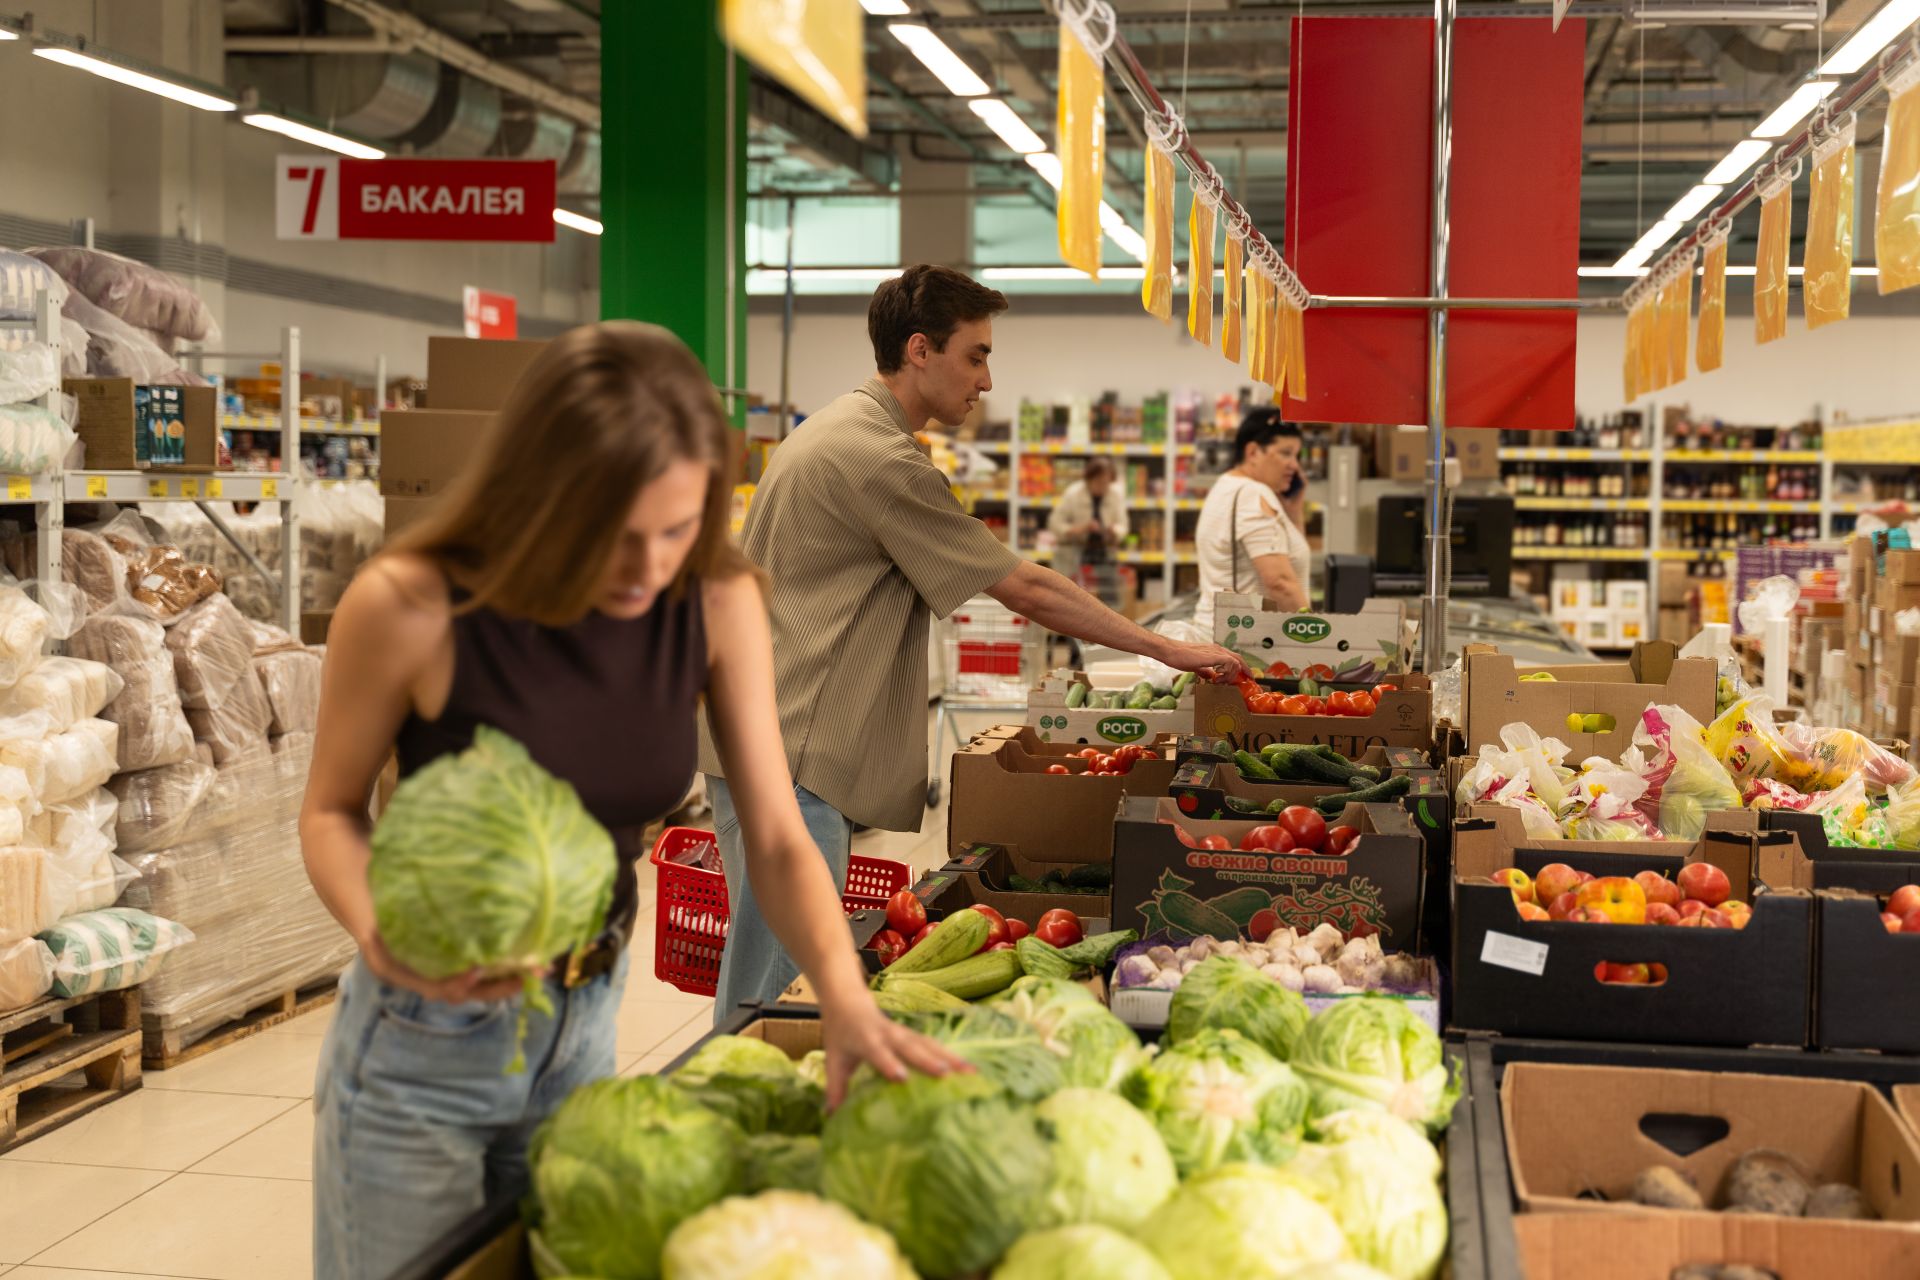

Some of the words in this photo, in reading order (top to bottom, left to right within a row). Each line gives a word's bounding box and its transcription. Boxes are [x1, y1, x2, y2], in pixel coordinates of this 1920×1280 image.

[288, 167, 326, 235] 7
[361, 184, 525, 215] БАКАЛЕЯ
[1288, 623, 1325, 634] РОСТ
[1102, 722, 1141, 734] РОСТ
[1186, 852, 1268, 871] свежие
[1271, 856, 1348, 878] овощи
[1216, 870, 1230, 881] от
[1230, 871, 1317, 884] производителя
